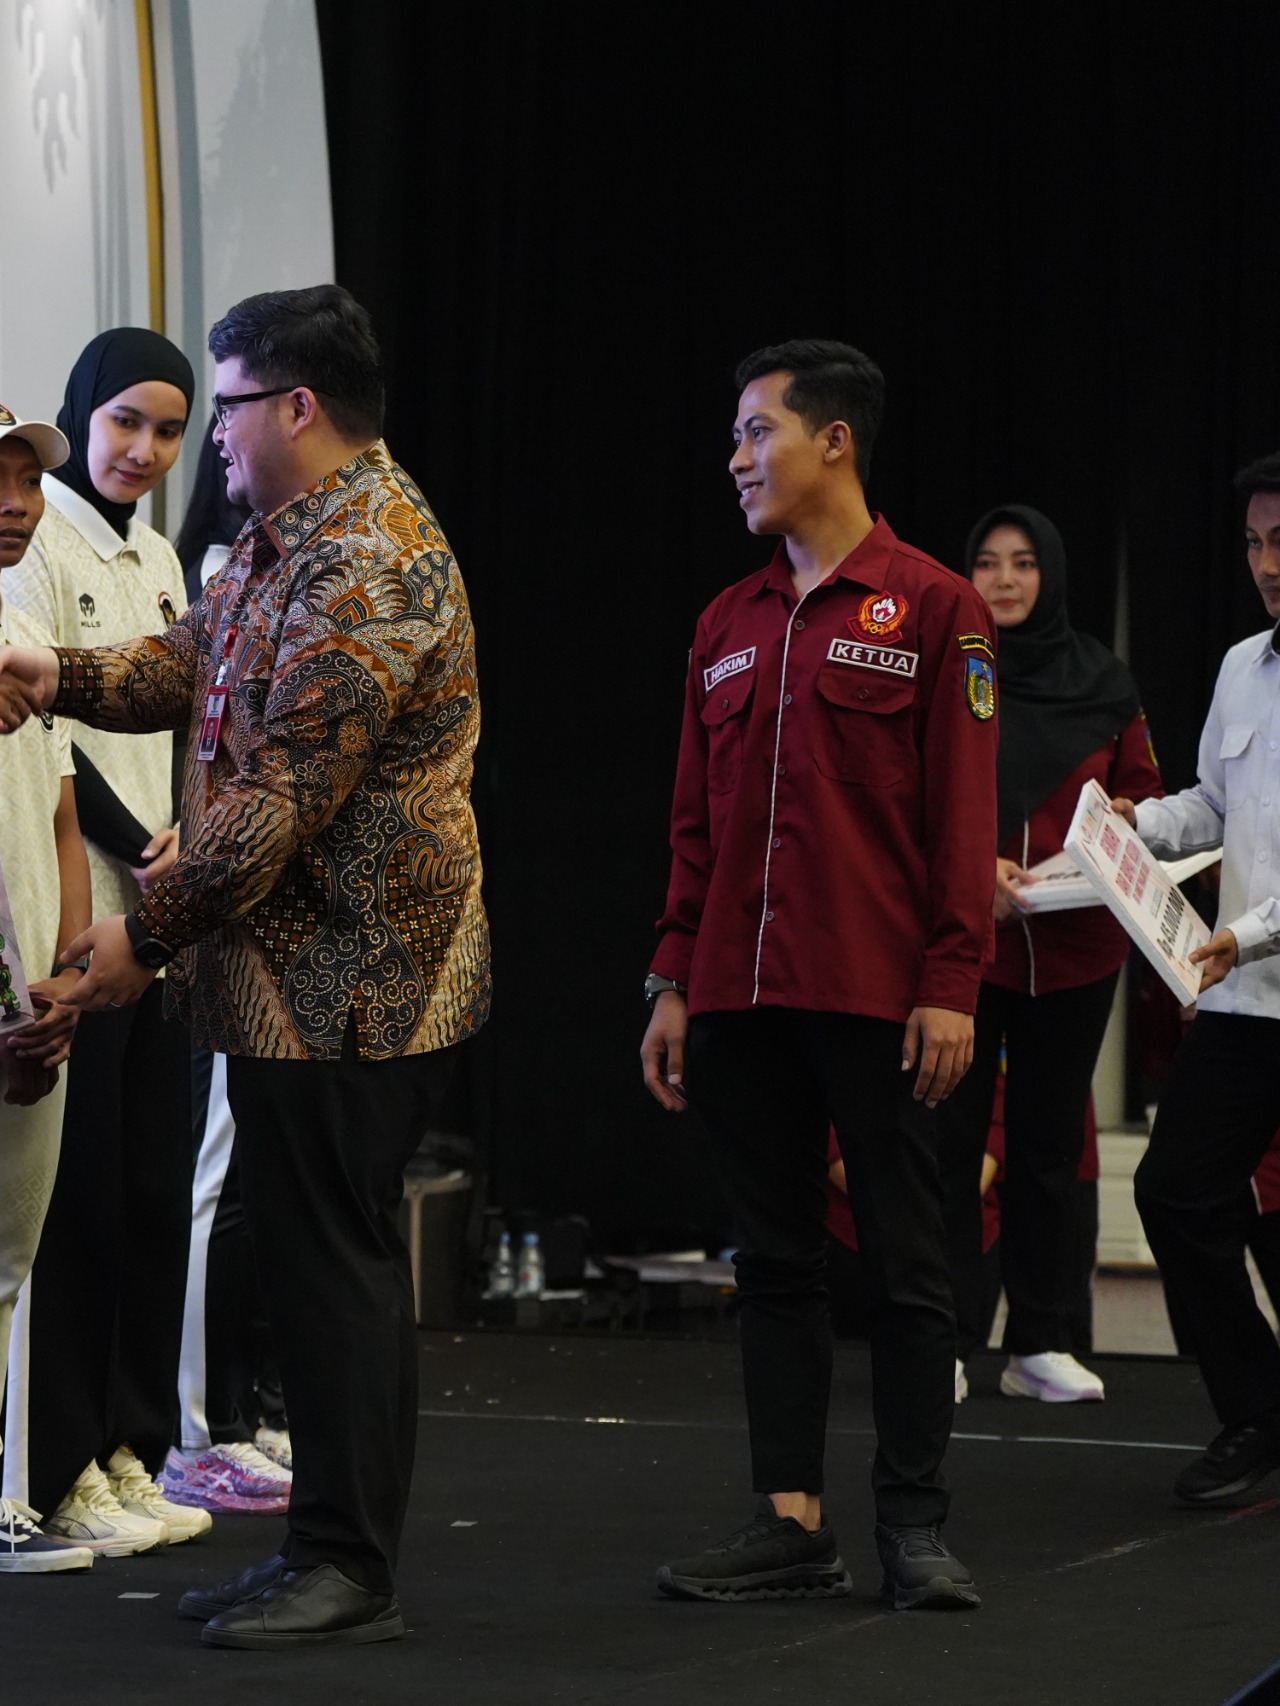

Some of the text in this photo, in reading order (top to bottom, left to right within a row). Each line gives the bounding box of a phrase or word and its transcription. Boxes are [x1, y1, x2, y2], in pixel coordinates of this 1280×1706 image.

[80, 620, 102, 628] MILLS
[710, 654, 748, 683] HAKIM
[834, 644, 910, 672] KETUA
